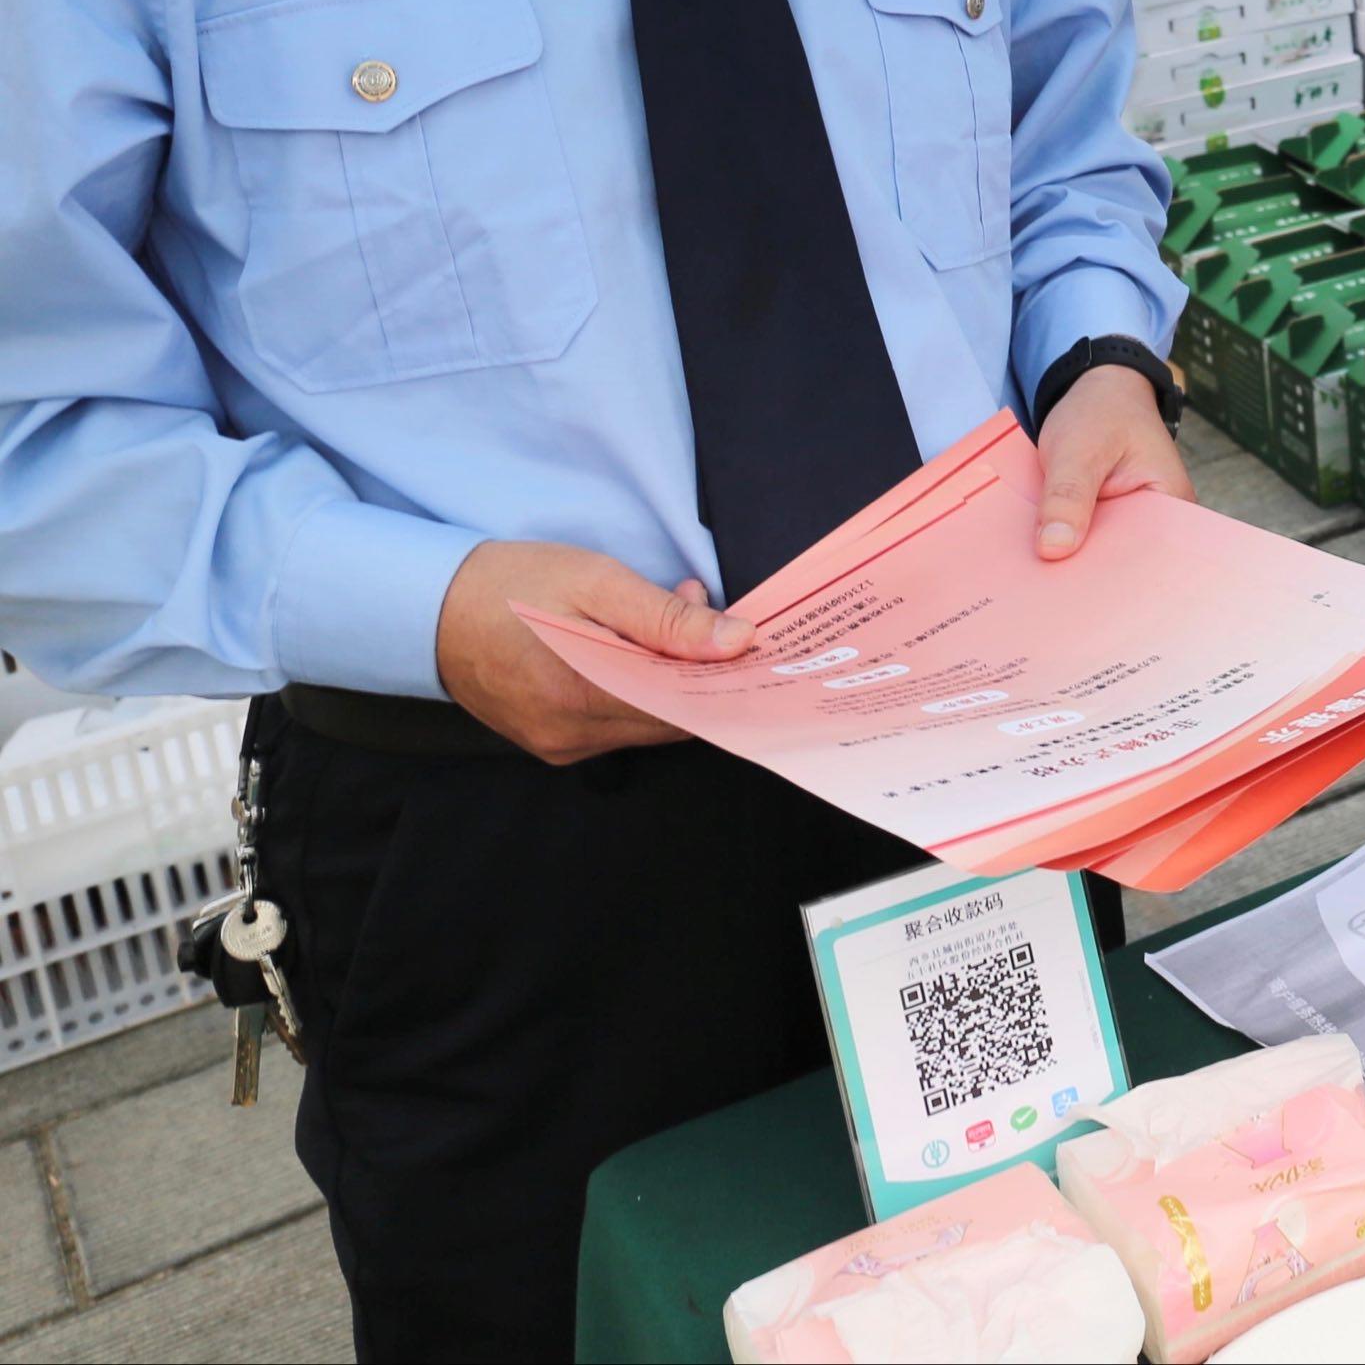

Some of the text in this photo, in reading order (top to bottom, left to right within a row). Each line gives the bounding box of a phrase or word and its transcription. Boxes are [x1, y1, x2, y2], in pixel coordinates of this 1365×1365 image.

[1023, 717, 1203, 779] 非接触式办税
[904, 892, 1004, 943] 聚合收款码
